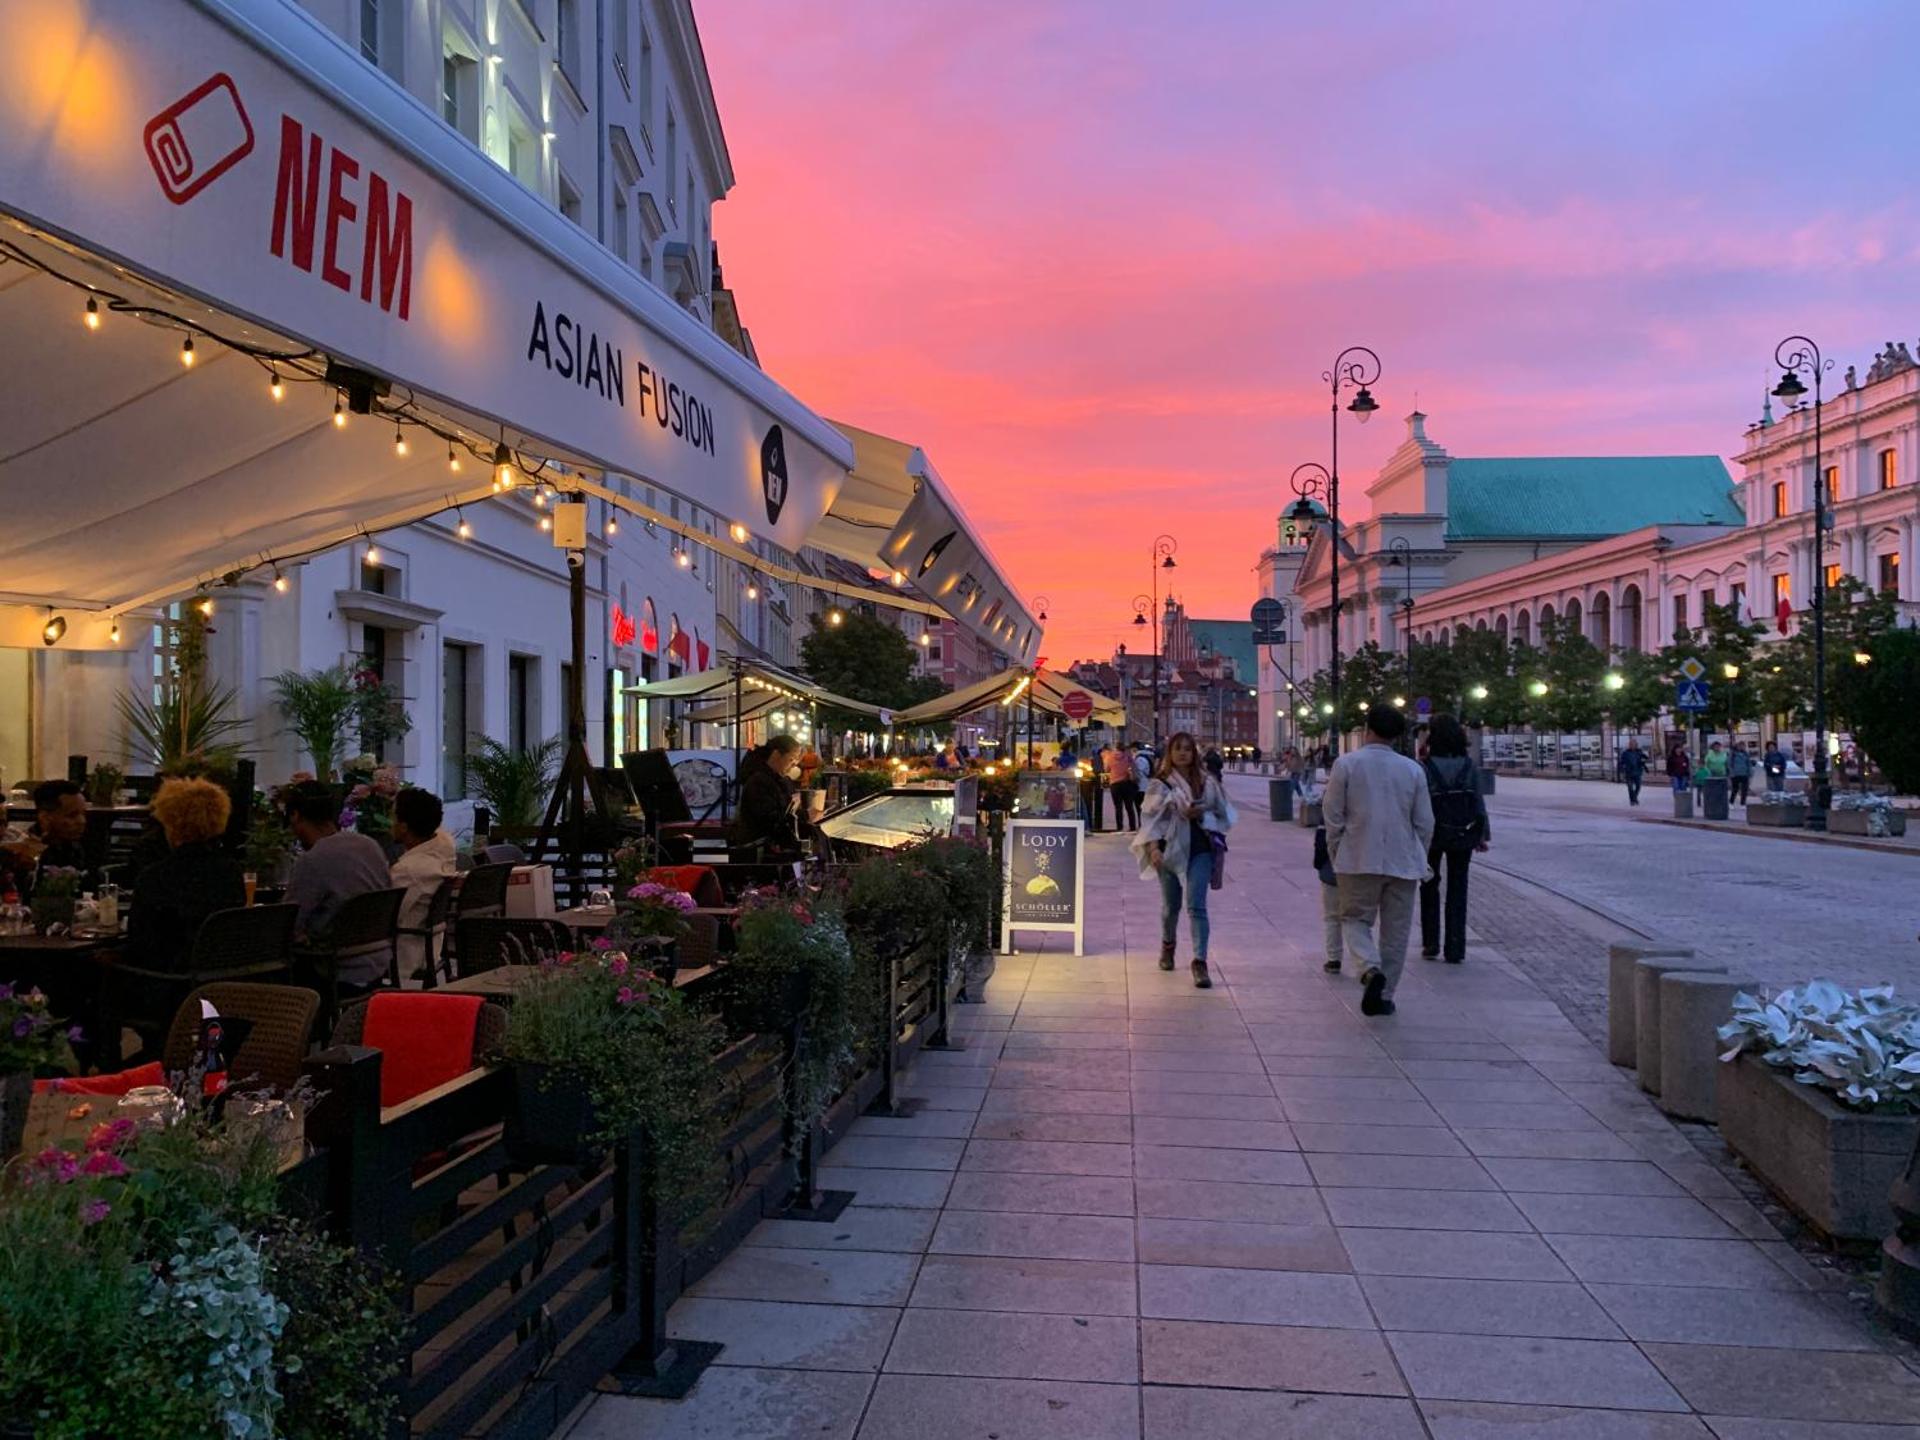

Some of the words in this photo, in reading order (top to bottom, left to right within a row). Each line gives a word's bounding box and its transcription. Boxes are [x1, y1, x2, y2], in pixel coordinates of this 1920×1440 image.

[271, 113, 412, 321] NEM
[528, 300, 624, 407] ASIAN
[638, 361, 715, 457] FUSION
[1021, 833, 1068, 848] LODY
